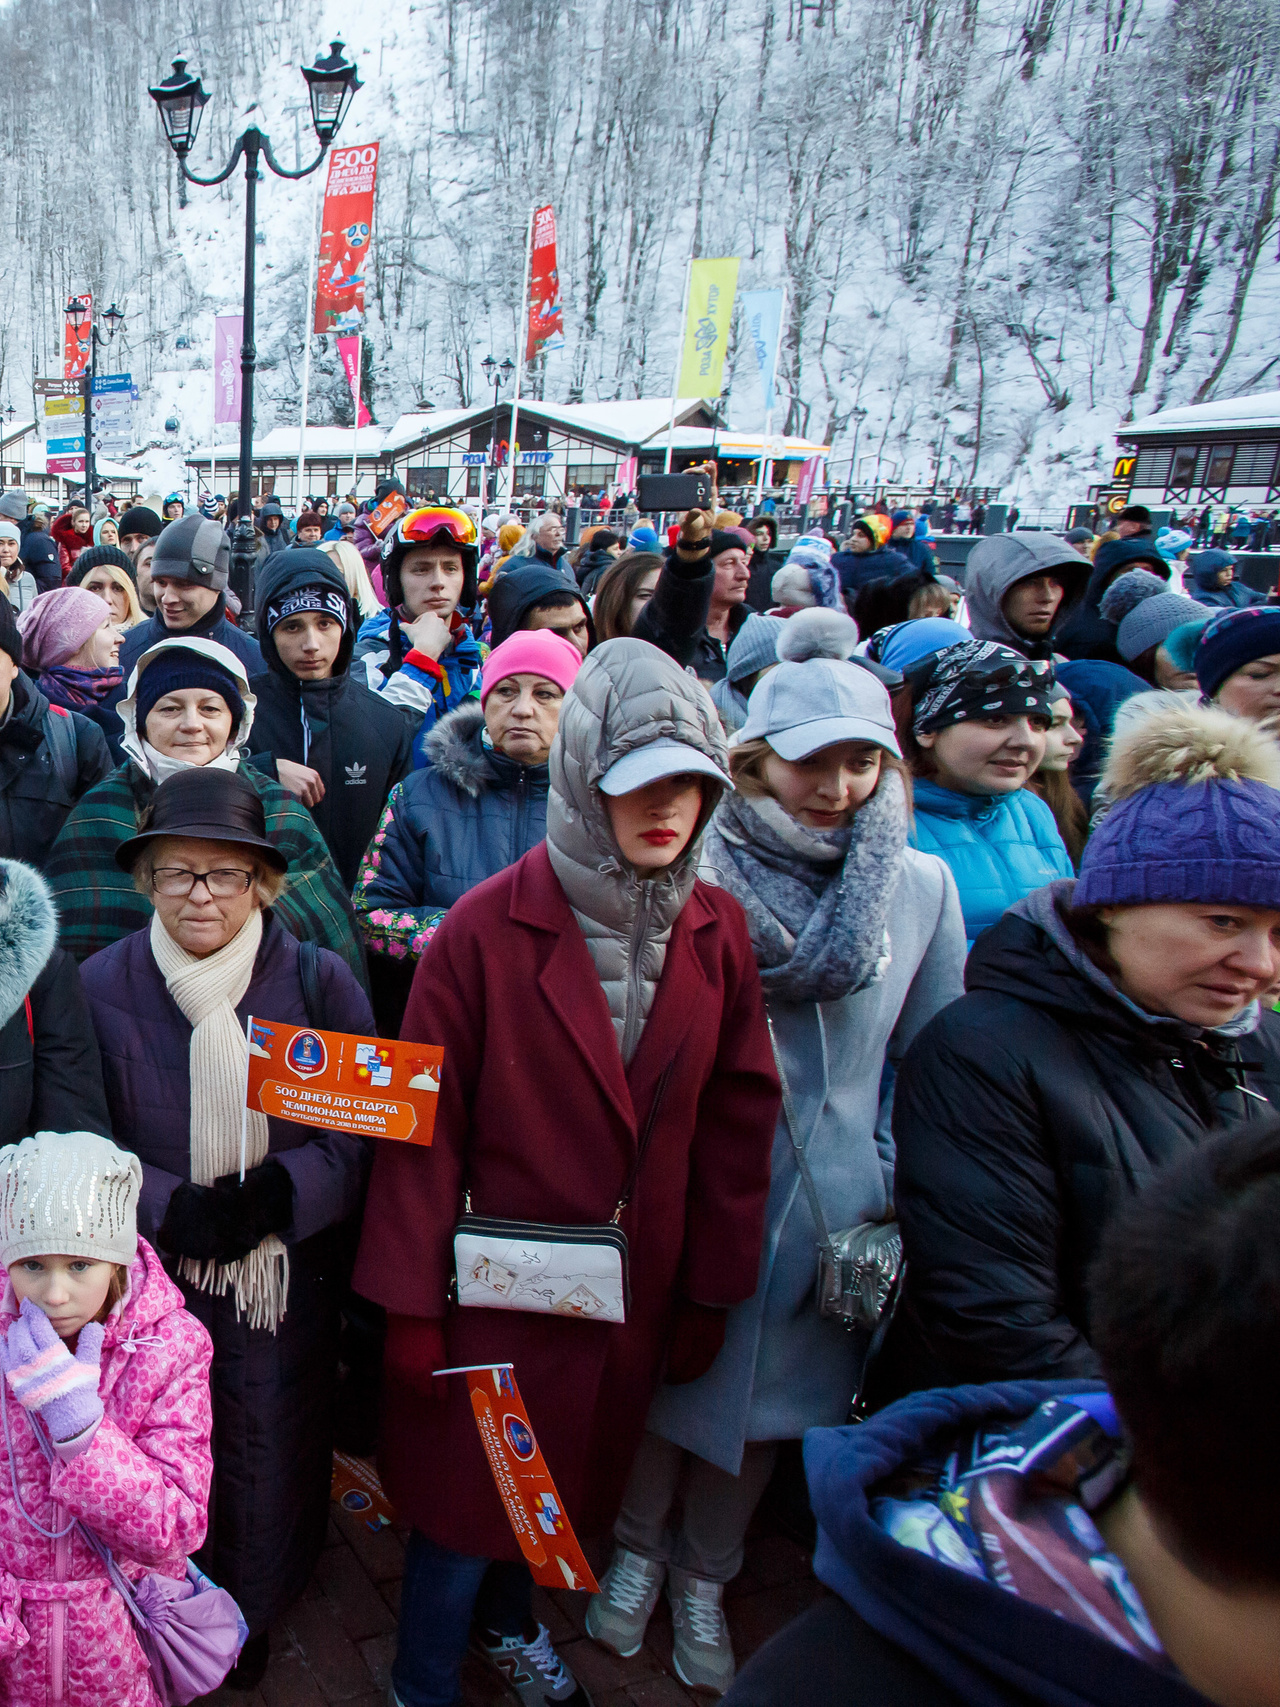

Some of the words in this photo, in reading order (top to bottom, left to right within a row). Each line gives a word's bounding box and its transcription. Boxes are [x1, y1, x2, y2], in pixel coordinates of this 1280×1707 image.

[331, 147, 377, 170] 500
[330, 166, 359, 180] ДНЕЙ
[359, 164, 375, 175] ДО
[462, 452, 486, 465] РОЗА
[521, 452, 554, 464] ХУТОР
[275, 1085, 297, 1098] 500
[299, 1090, 331, 1105] ДНЕЙ
[332, 1096, 351, 1108] ДО
[353, 1099, 399, 1114] СТАРТА
[282, 1099, 353, 1120] ЧЕМПИОНАТА
[354, 1113, 386, 1125] МИРА
[291, 1112, 321, 1123] ФУТБОЛУ
[357, 1124, 386, 1133] РОССИИ
[482, 1416, 511, 1496] ЧЕМПИОНАТА
[508, 1498, 525, 1534] МИРА
[485, 1406, 496, 1433] 500
[493, 1435, 510, 1471] ДНЕЙ
[505, 1473, 517, 1493] ДО
[514, 1495, 538, 1546] СТАРТА
